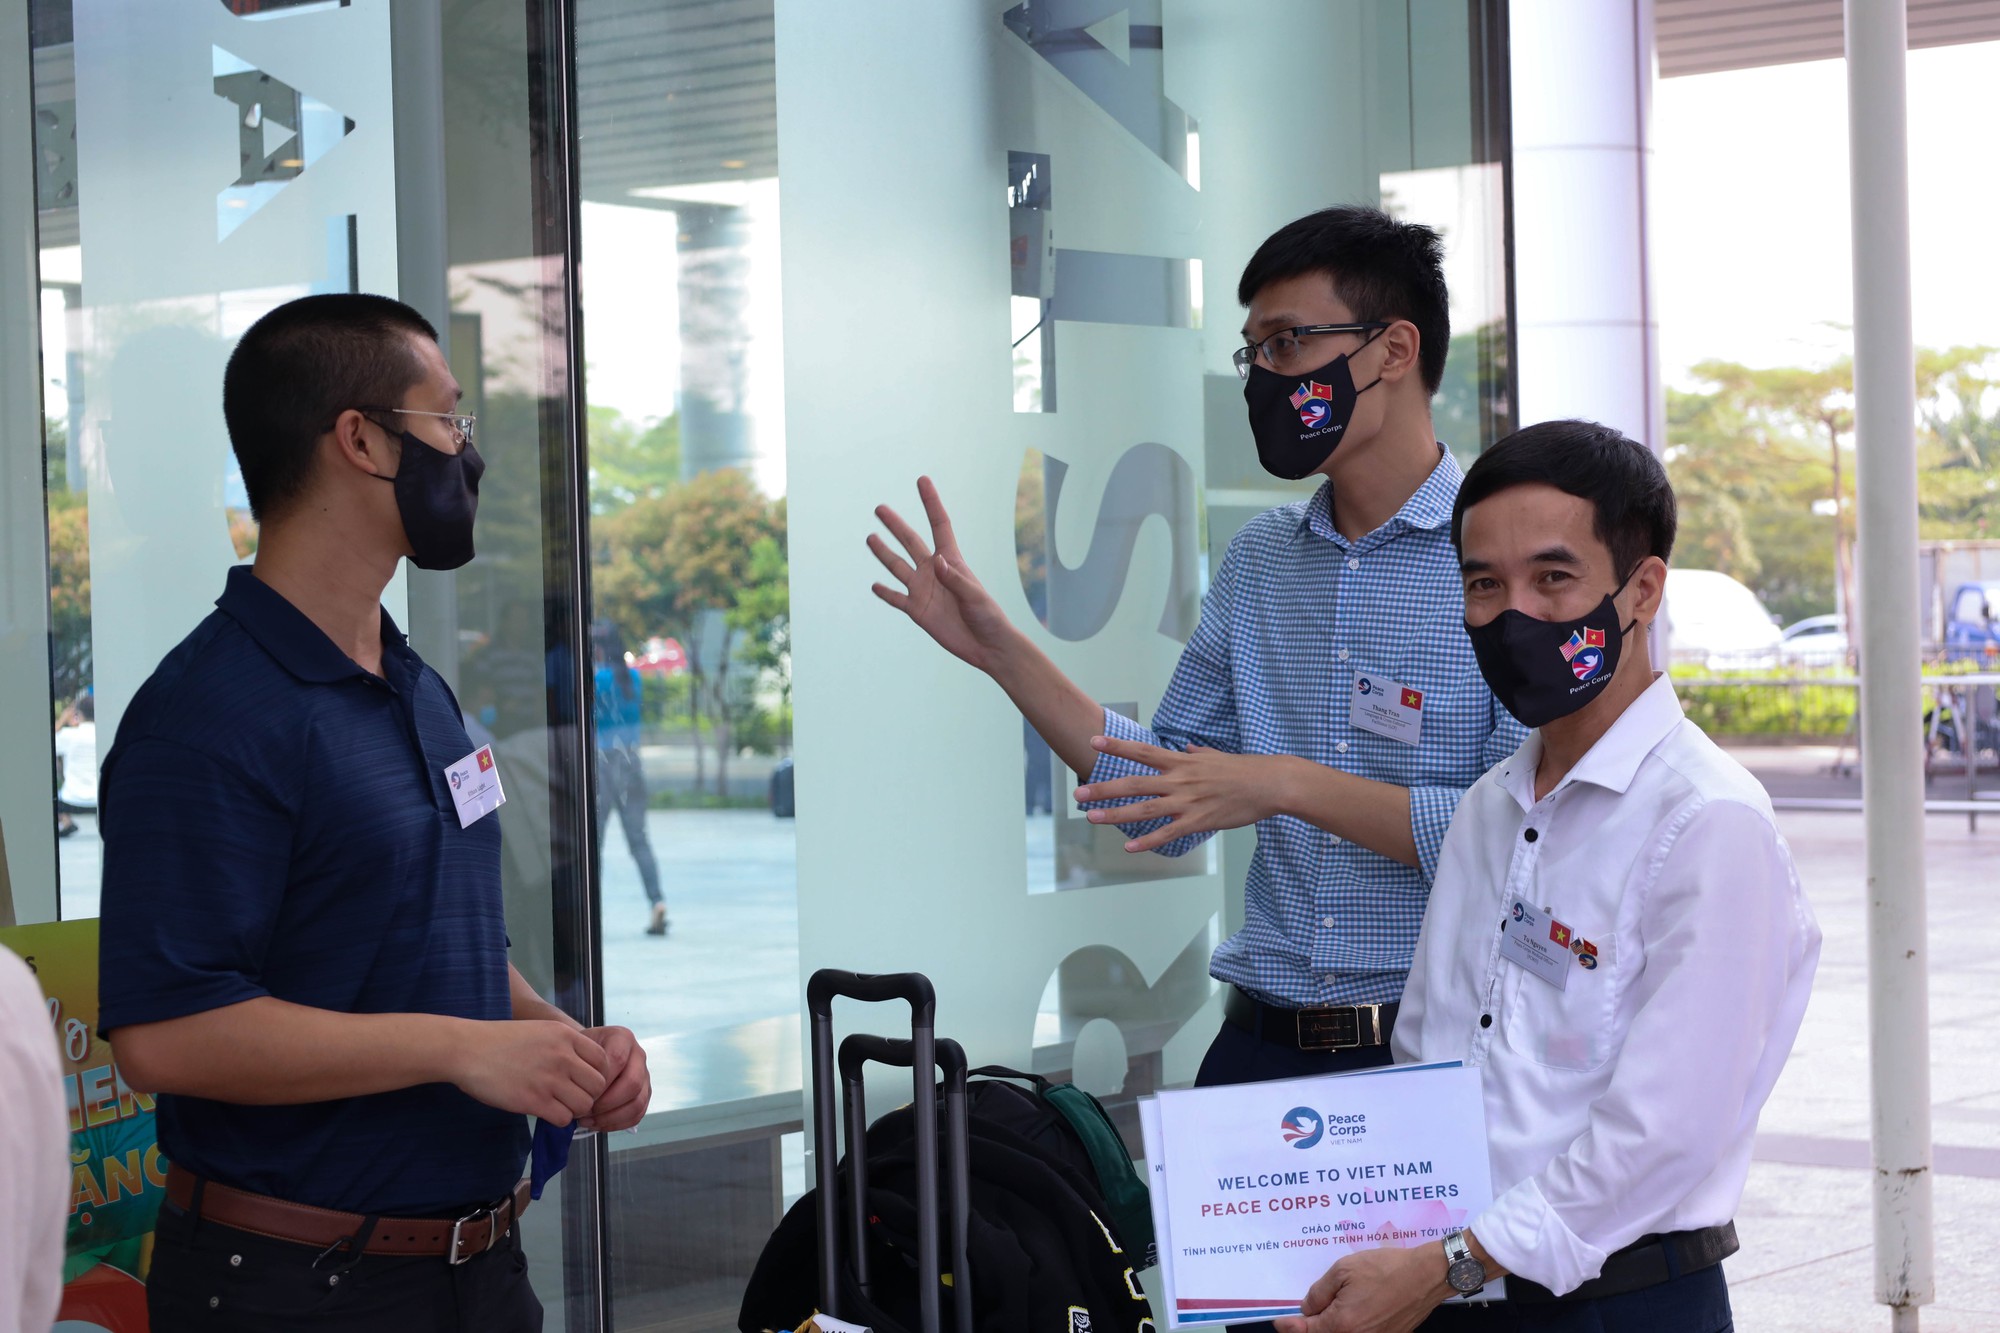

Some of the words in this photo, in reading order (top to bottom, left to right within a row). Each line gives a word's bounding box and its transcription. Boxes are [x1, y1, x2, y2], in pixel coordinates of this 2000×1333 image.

[1300, 431, 1321, 440] Peace
[1321, 424, 1343, 434] Corps
[1569, 682, 1590, 694] Peace
[1591, 672, 1612, 684] Corps
[1328, 1114, 1366, 1125] Peace
[1329, 1125, 1367, 1136] Corps
[1218, 1171, 1310, 1190] WELCOME
[1316, 1168, 1340, 1182] TO
[1347, 1165, 1386, 1180] VIET
[1394, 1161, 1433, 1177] NAM
[1201, 1200, 1262, 1217] PEACE
[1268, 1194, 1331, 1212] CORPS
[1337, 1184, 1459, 1206] VOLUNTEERS
[1301, 1224, 1331, 1234] CHÀO
[1334, 1221, 1366, 1231] MỪNG
[1183, 1246, 1206, 1256] TÌNH
[1256, 1240, 1280, 1251] VIÊN
[1283, 1237, 1329, 1249] CHƯƠNG
[1332, 1233, 1364, 1245] TRÌNH
[1367, 1232, 1389, 1241] HÒA
[1393, 1229, 1417, 1239] BÌNH
[1421, 1226, 1439, 1237] TỚI
